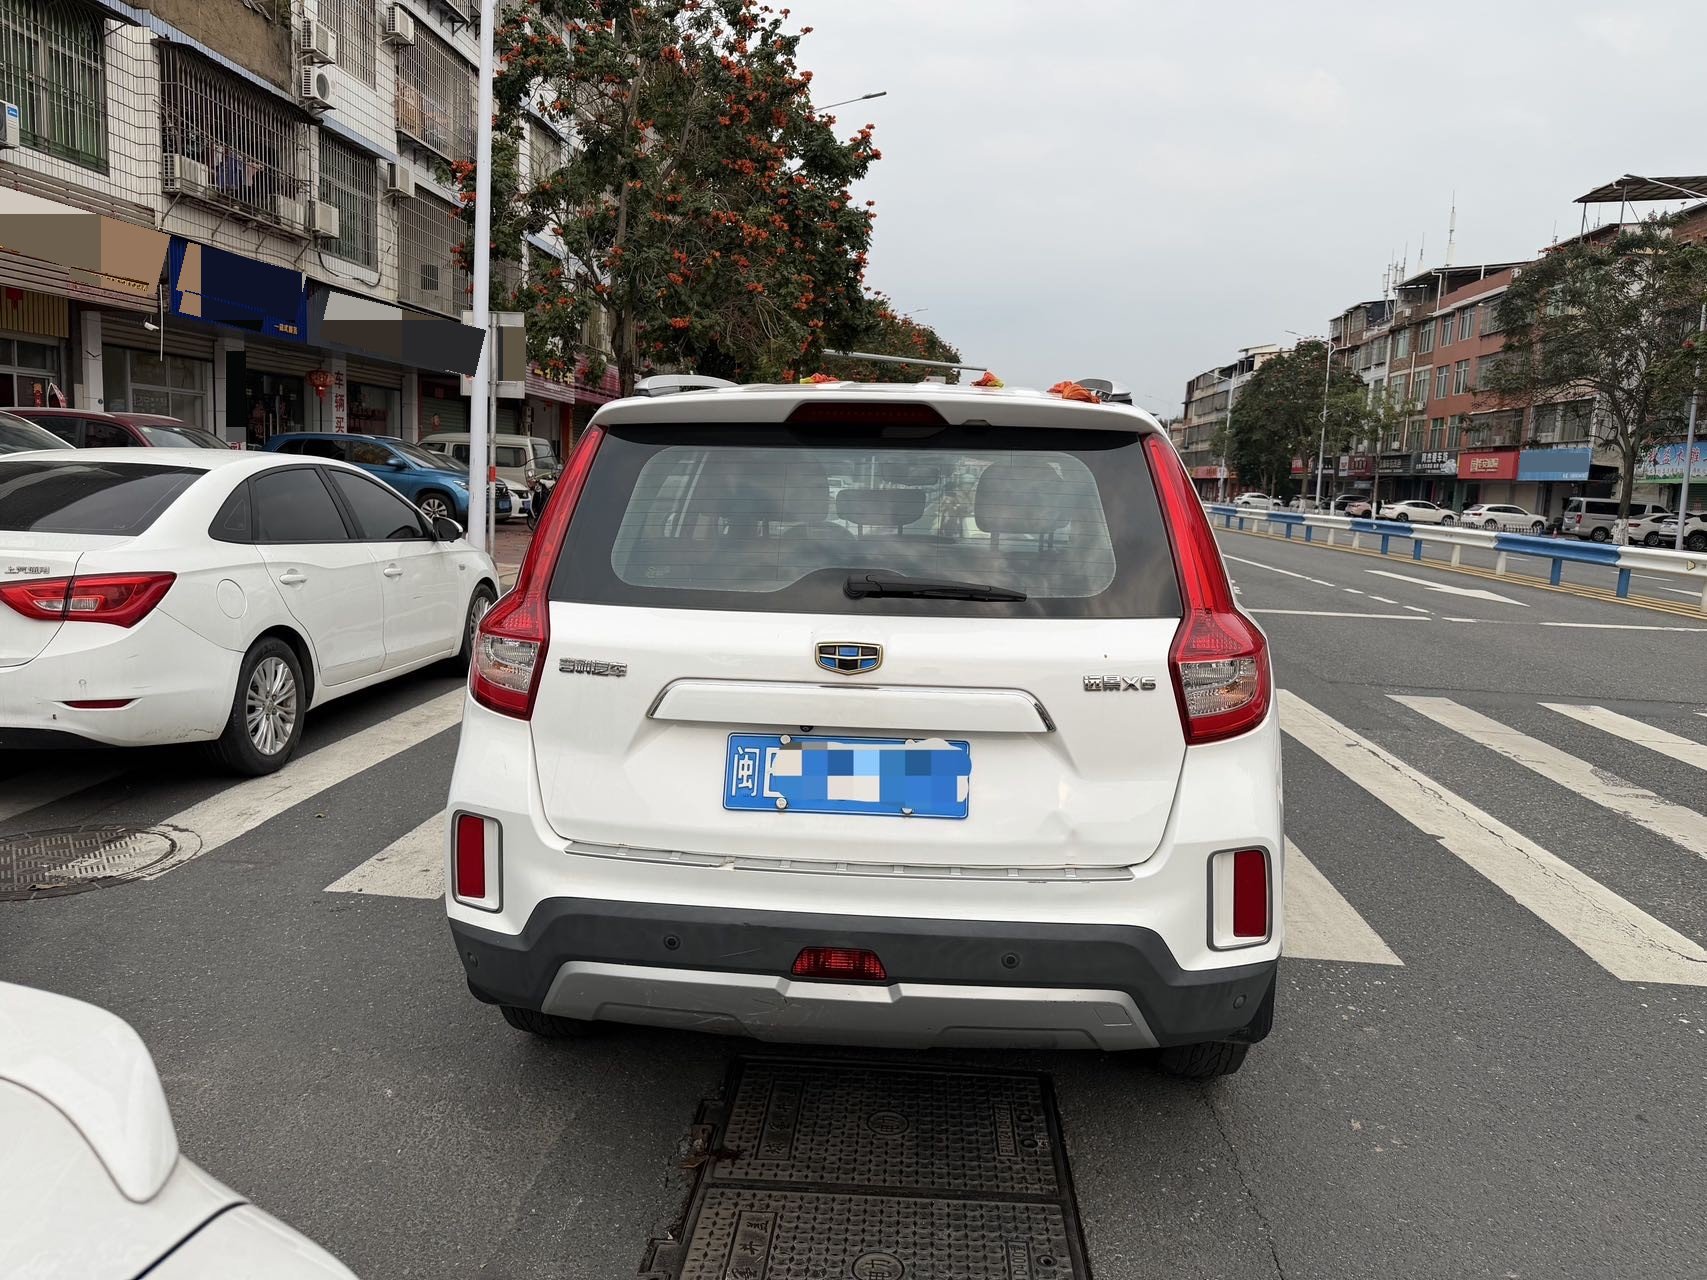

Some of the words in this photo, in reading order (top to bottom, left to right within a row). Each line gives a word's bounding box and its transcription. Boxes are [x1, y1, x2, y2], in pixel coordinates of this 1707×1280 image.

[559, 657, 627, 678] 吉利汽车
[1083, 674, 1156, 692] 远景X6
